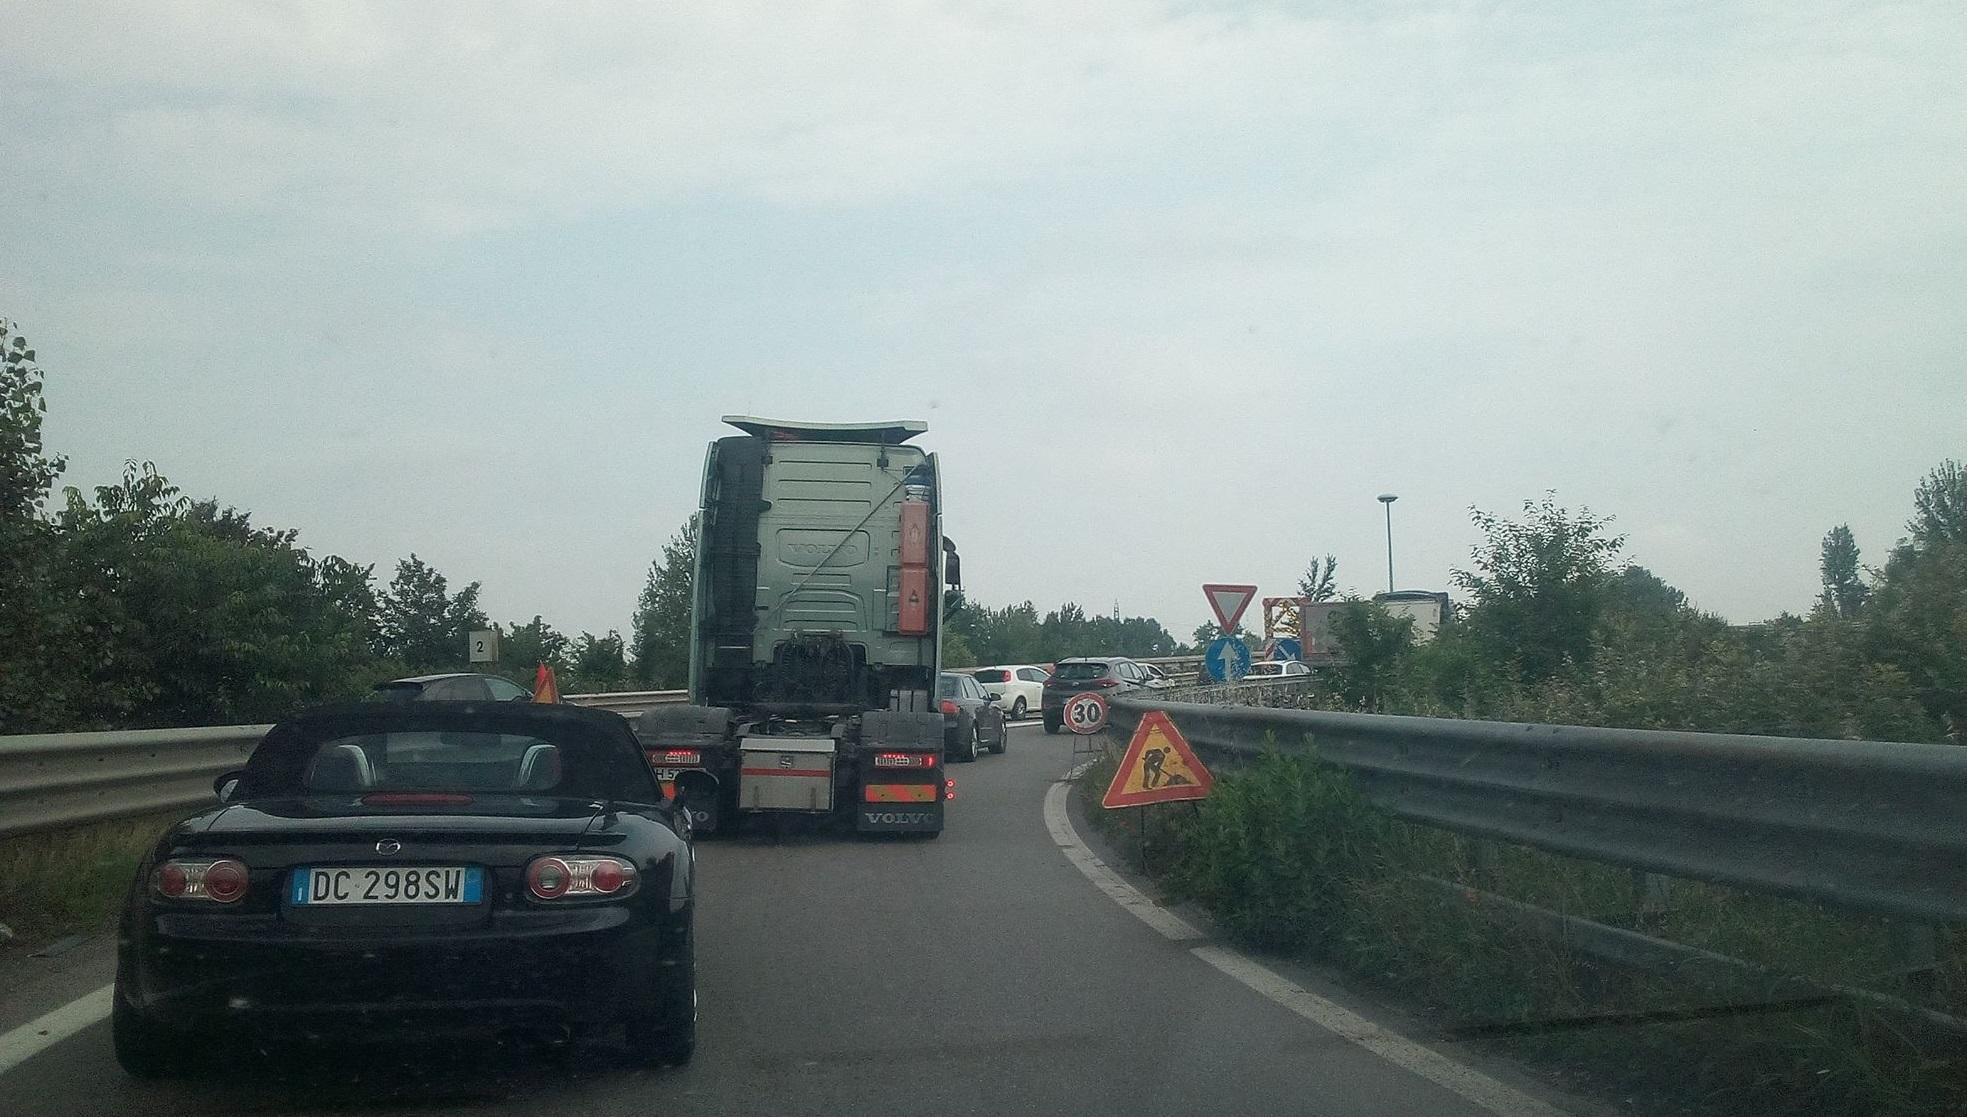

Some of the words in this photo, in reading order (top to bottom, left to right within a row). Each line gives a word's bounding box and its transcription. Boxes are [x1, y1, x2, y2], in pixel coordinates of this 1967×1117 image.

[476, 640, 484, 653] 2
[1073, 703, 1100, 723] 30
[313, 870, 351, 901] DC
[363, 869, 461, 900] 298SW
